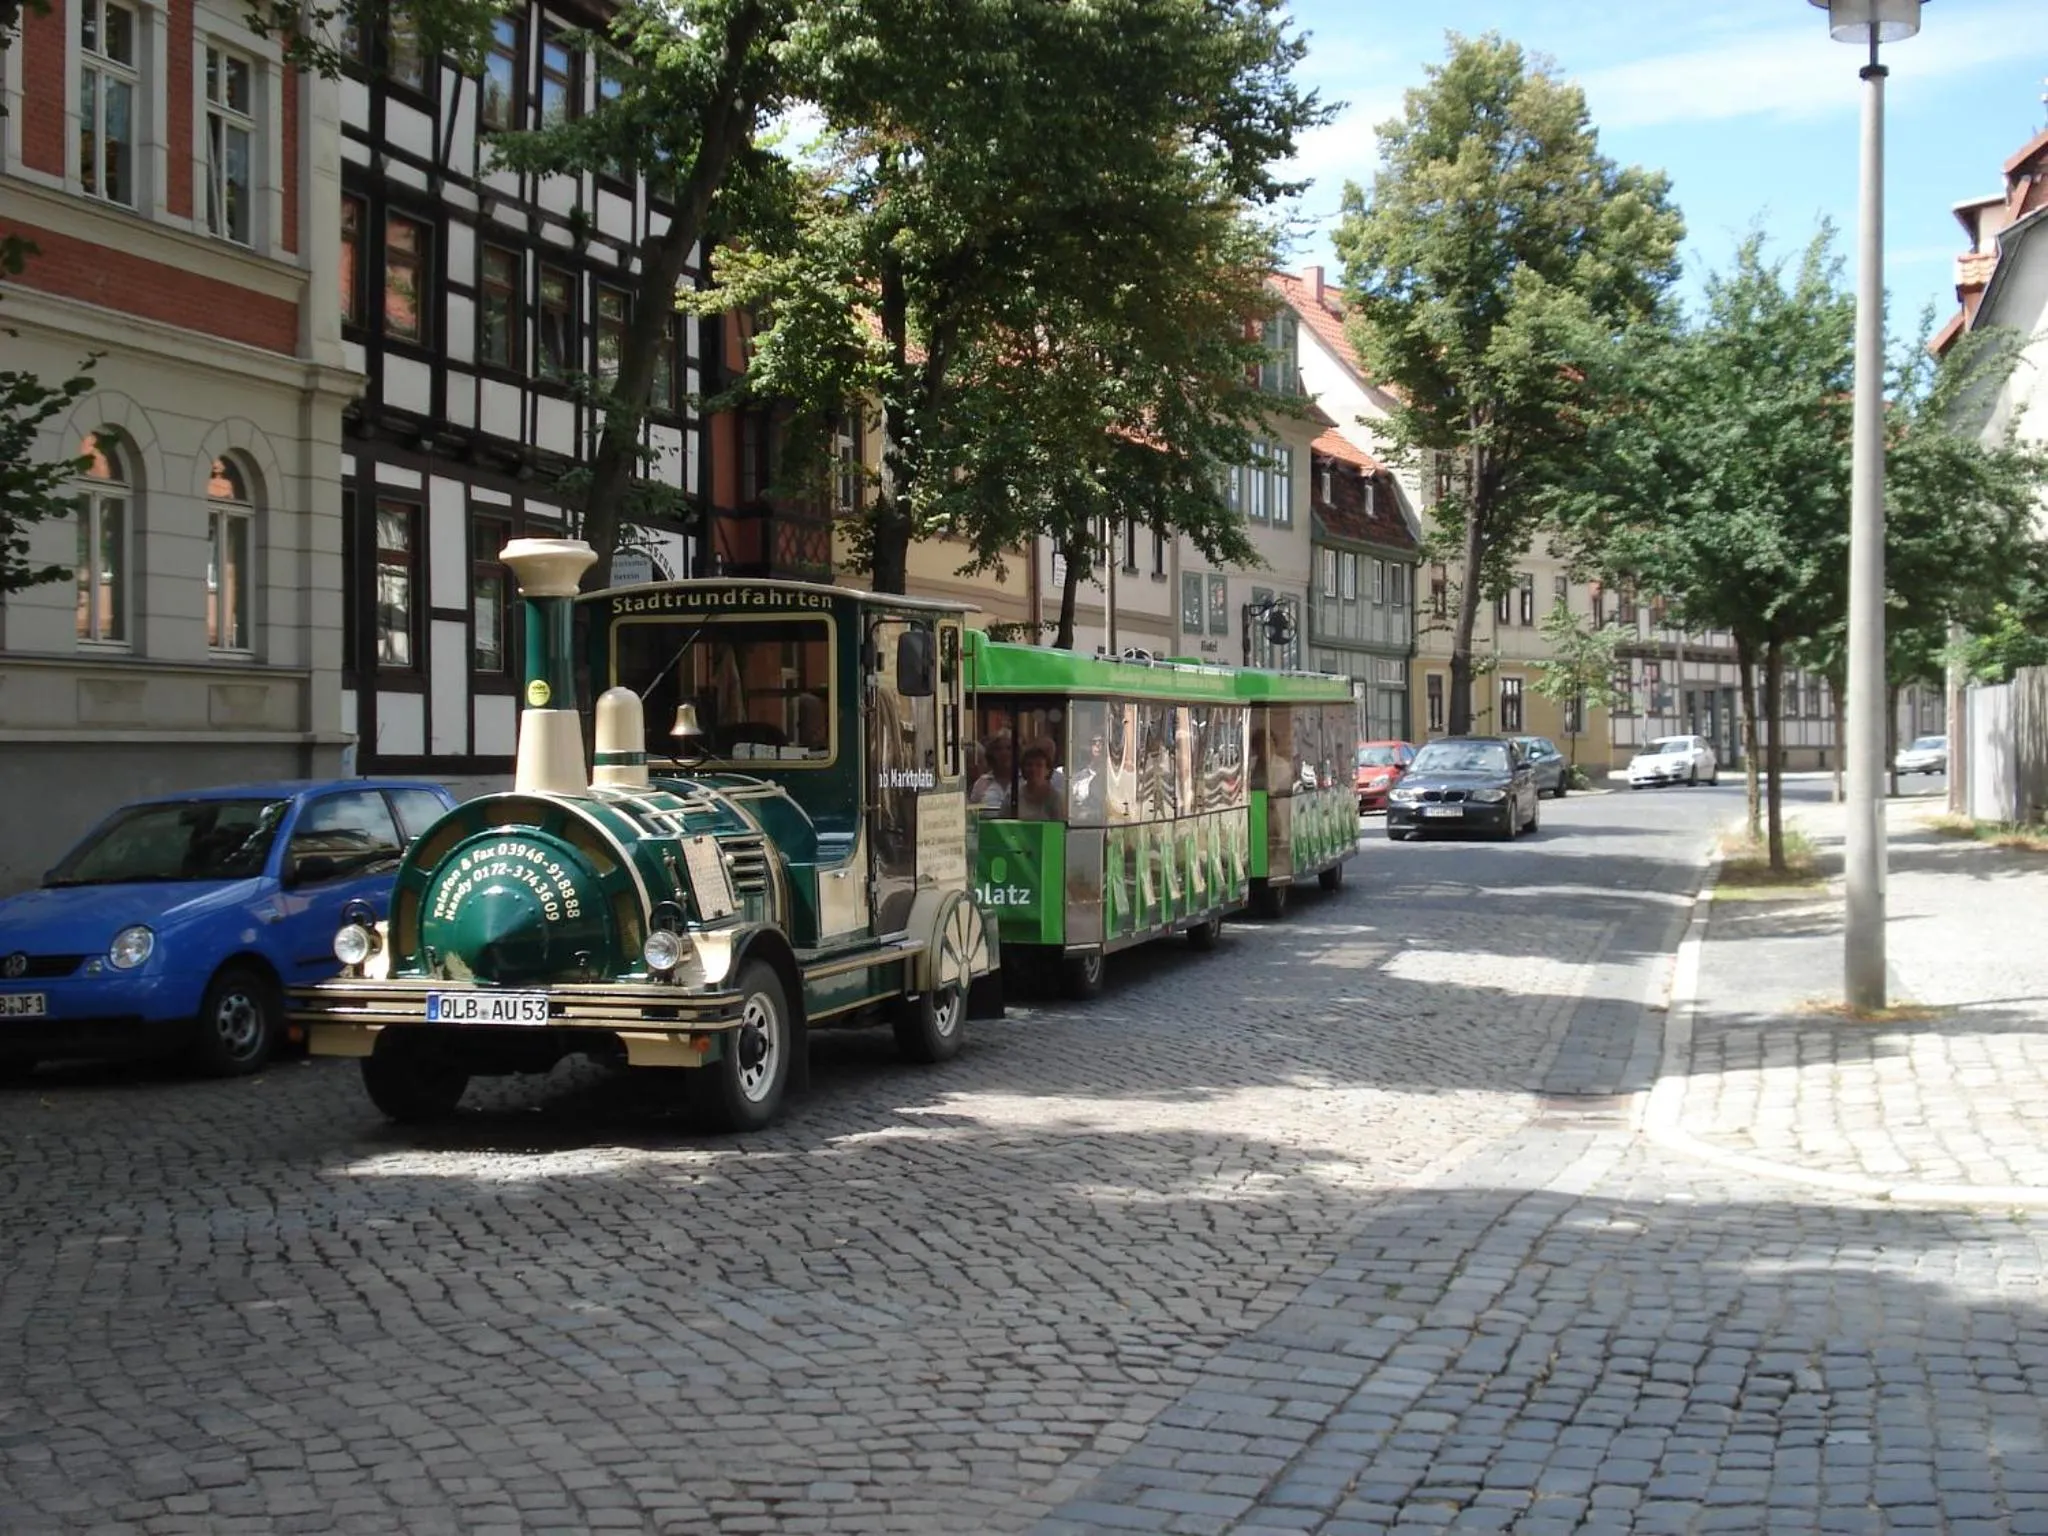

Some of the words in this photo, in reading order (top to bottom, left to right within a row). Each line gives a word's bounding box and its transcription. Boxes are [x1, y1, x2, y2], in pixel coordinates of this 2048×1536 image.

[612, 588, 833, 614] Stadtrundfahrten
[891, 767, 934, 793] Marktplatz
[433, 868, 462, 919] Telefon
[461, 857, 473, 871] &
[472, 846, 496, 864] Fax
[497, 843, 581, 918] 03946-918888
[445, 878, 473, 921] Handy
[472, 862, 561, 921] 0172-3743609
[440, 999, 478, 1019] QLB
